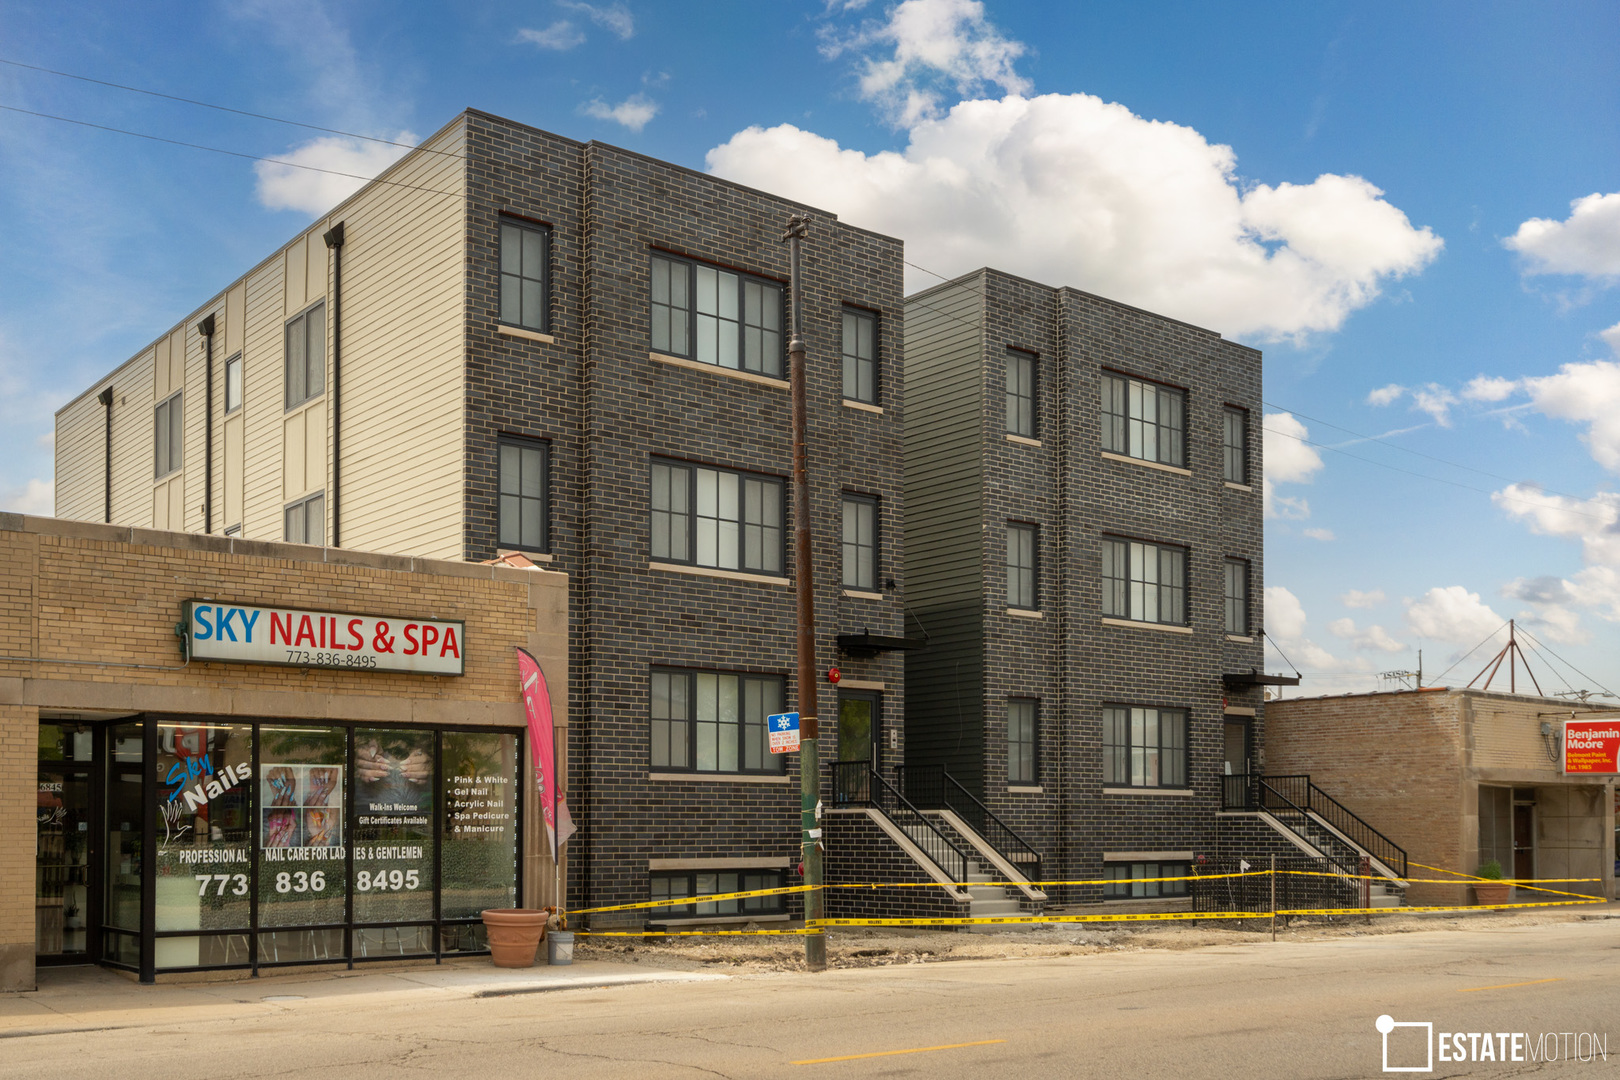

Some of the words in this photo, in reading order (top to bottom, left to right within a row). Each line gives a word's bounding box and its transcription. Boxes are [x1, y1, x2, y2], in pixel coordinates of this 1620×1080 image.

[194, 605, 260, 643] SKY
[270, 612, 364, 651] NAILS
[372, 620, 395, 654] &
[403, 624, 460, 658] SPA
[286, 650, 376, 668] 773-836-8495
[1568, 728, 1620, 740] Benjamin
[1568, 739, 1604, 749] Moore
[166, 754, 214, 802] Sky
[40, 783, 62, 792] 6845
[183, 762, 252, 812] Nails
[369, 803, 392, 811] Walk-Ins
[393, 803, 418, 811] Welcome
[454, 800, 484, 809] Acrylic
[359, 816, 370, 824] Gift
[370, 816, 402, 824] Certificates
[403, 816, 428, 825] Available
[454, 812, 470, 821] Spa
[180, 849, 248, 863] PROFESSIONAL
[265, 848, 285, 861] NAIL
[287, 848, 310, 861] CARE
[311, 847, 328, 860] FOR
[368, 847, 374, 859] &
[376, 846, 423, 859] GENTLEMEN
[195, 874, 248, 896] 773
[276, 871, 326, 893] 836
[357, 870, 419, 891] 8495
